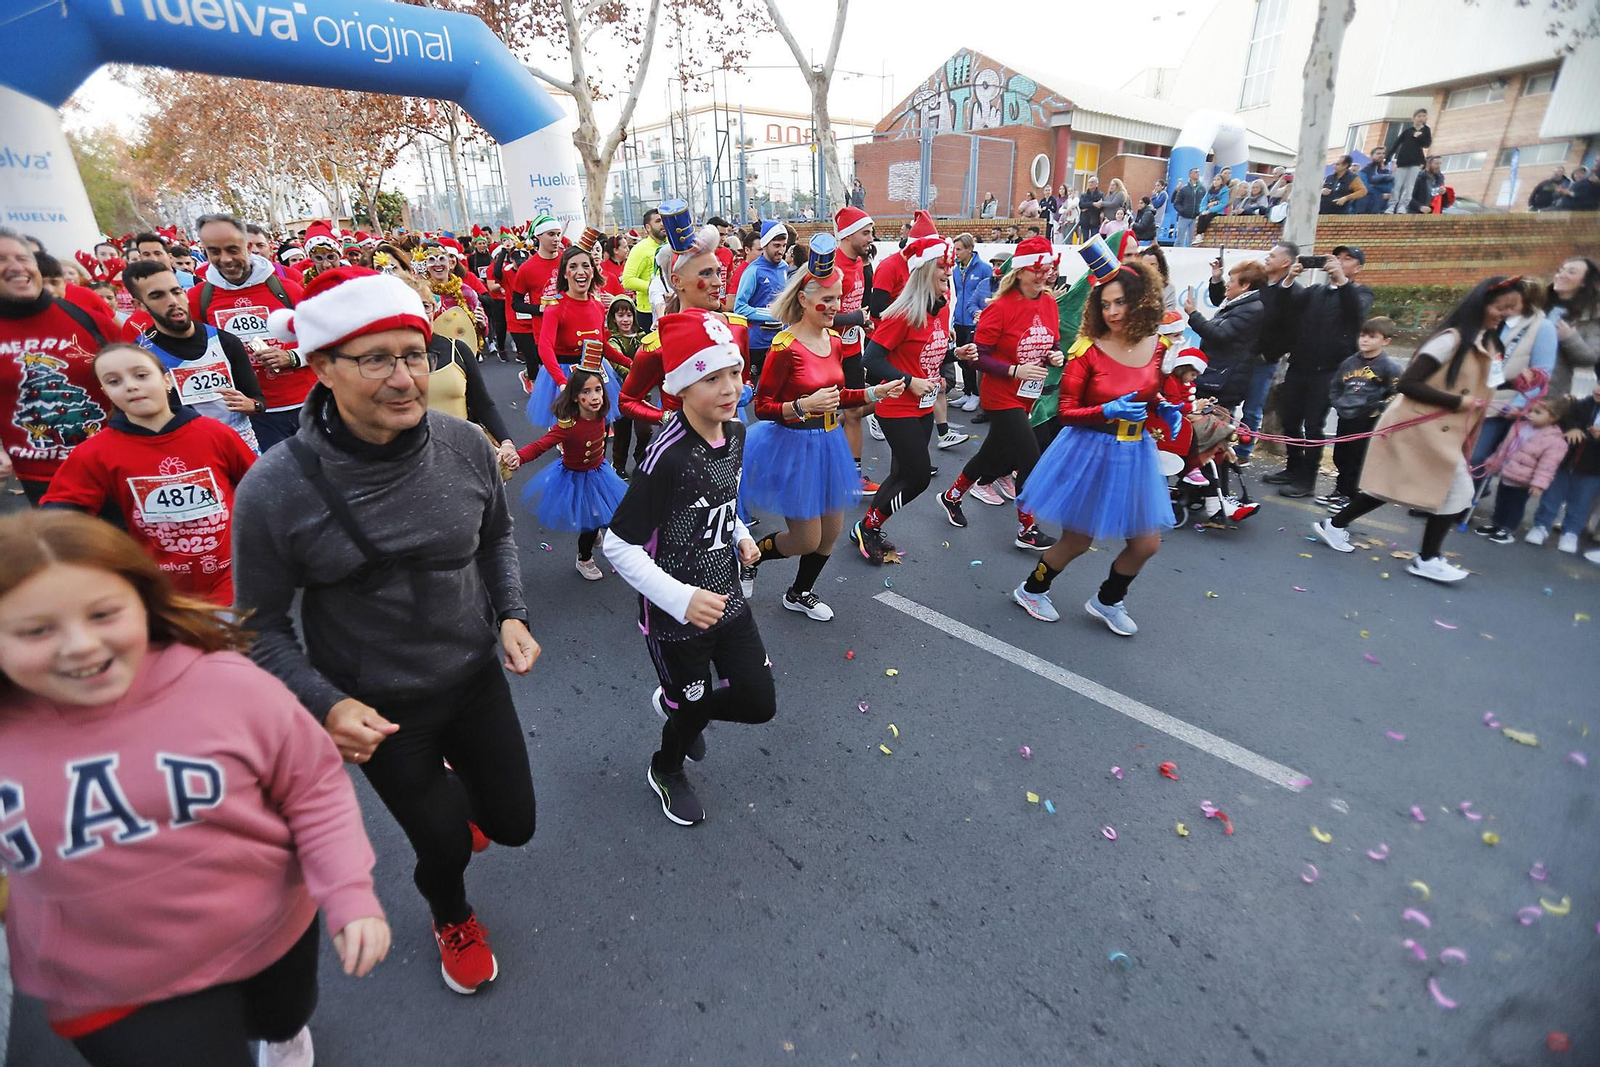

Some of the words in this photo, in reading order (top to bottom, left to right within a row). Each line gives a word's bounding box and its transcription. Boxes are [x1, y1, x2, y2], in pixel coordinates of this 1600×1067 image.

[313, 11, 453, 63] original
[529, 172, 576, 187] Huelva
[7, 211, 68, 222] HUELVA
[232, 316, 259, 331] 488
[190, 373, 220, 391] 325
[9, 446, 73, 460] CHRIS
[157, 485, 196, 508] 487
[179, 523, 226, 536] DICIEMBRE
[703, 499, 738, 551] T
[160, 536, 219, 553] 2023
[159, 562, 191, 572] elva
